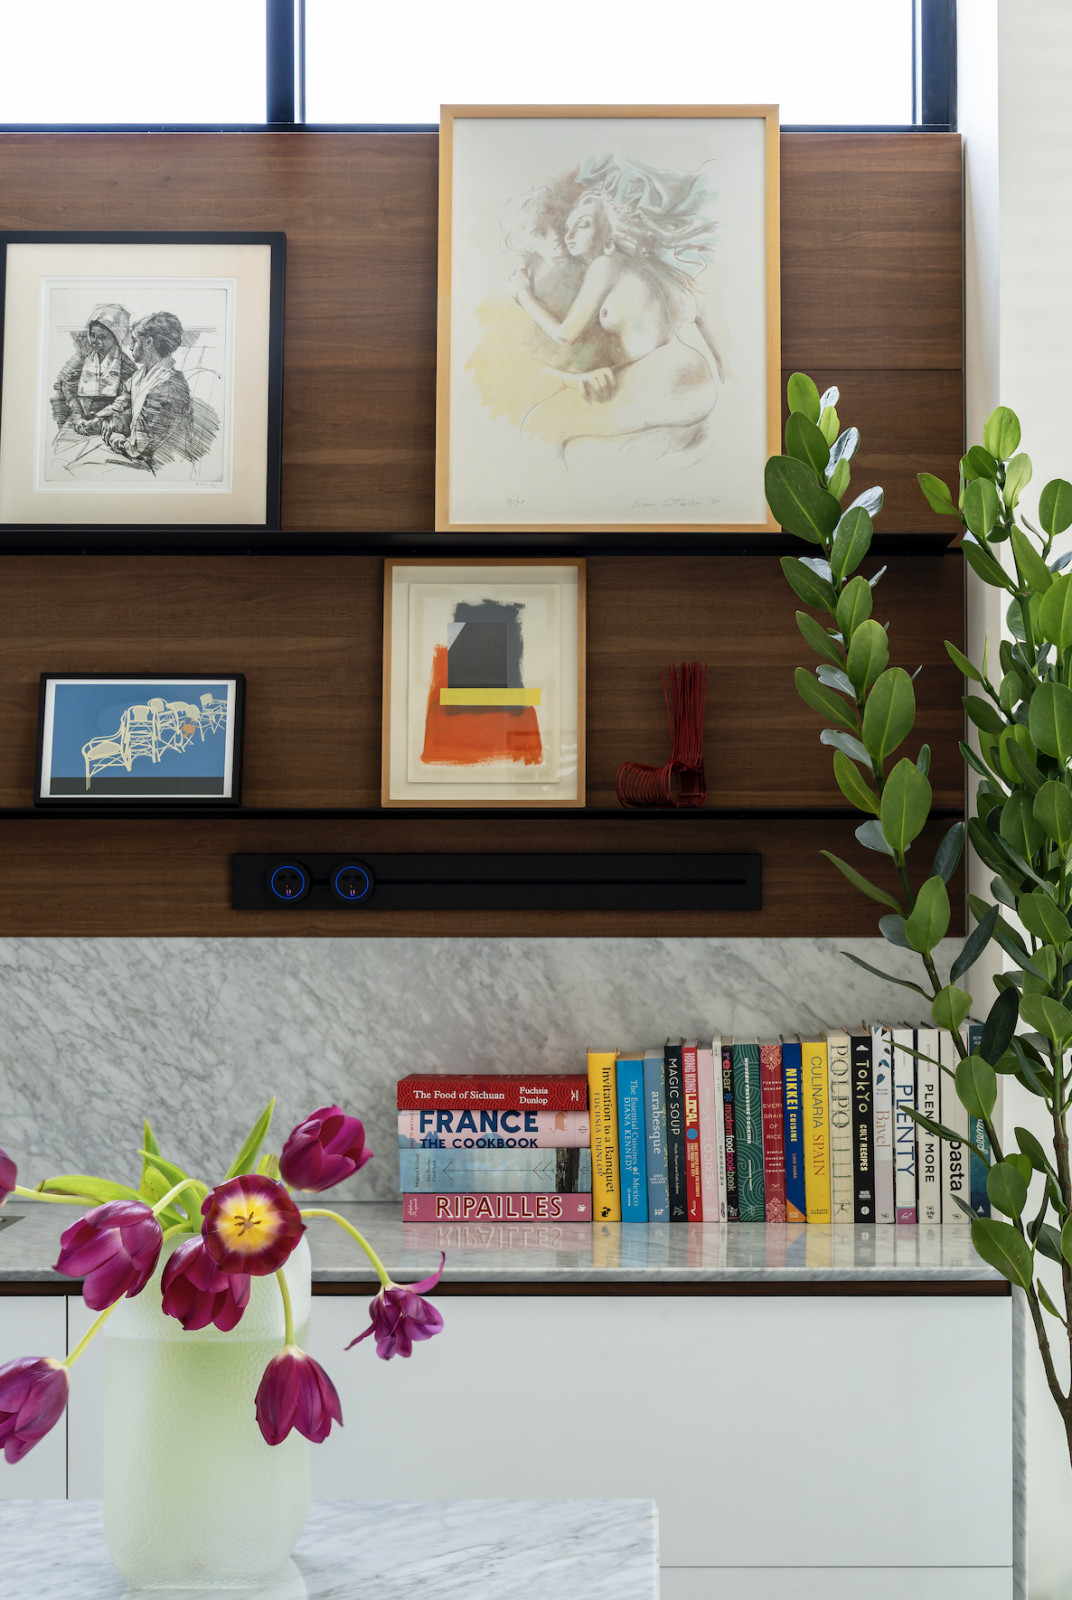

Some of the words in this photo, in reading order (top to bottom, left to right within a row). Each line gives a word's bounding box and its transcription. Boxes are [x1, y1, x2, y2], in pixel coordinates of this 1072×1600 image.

[668, 1058, 679, 1098] MAGIC
[684, 1052, 695, 1072] HONG
[722, 1052, 732, 1091] rebar
[413, 1090, 431, 1099] The
[434, 1091, 456, 1099] Food
[459, 1090, 468, 1099] of
[470, 1091, 505, 1100] Sichuan
[519, 1086, 548, 1095] Fuchsia
[602, 1067, 613, 1121] Invitation
[630, 1080, 638, 1095] The
[685, 1074, 696, 1093] KONG
[785, 1068, 799, 1110] NIKKEI
[811, 1056, 823, 1128] CULINARIA
[830, 1044, 851, 1129] POLPO
[519, 1096, 548, 1105] Dunlop
[594, 1092, 602, 1133] FUCHSIA
[631, 1097, 639, 1130] Essential
[685, 1093, 697, 1126] LOCAL
[925, 1084, 934, 1137] PLENY
[419, 1110, 539, 1133] FRANCE
[604, 1125, 611, 1134] to
[649, 1091, 664, 1154] arabesque
[670, 1103, 681, 1135] SOUP
[789, 1113, 797, 1142] CUISINE
[859, 1124, 868, 1141] CULT
[876, 1110, 891, 1147] Bavel
[896, 1085, 915, 1176] PLENTY
[420, 1139, 446, 1148] THE
[452, 1138, 538, 1148] COOKBOOK
[595, 1138, 603, 1177] DUNLOP
[624, 1130, 632, 1172] KENNEDY
[631, 1132, 639, 1164] Cuisines
[812, 1134, 825, 1177] SPAIN
[860, 1144, 868, 1171] RECIPES
[602, 1146, 615, 1193] Banquet
[925, 1143, 935, 1183] MORE
[436, 1196, 563, 1219] RIPAILLES
[632, 1177, 640, 1207] Mexico
